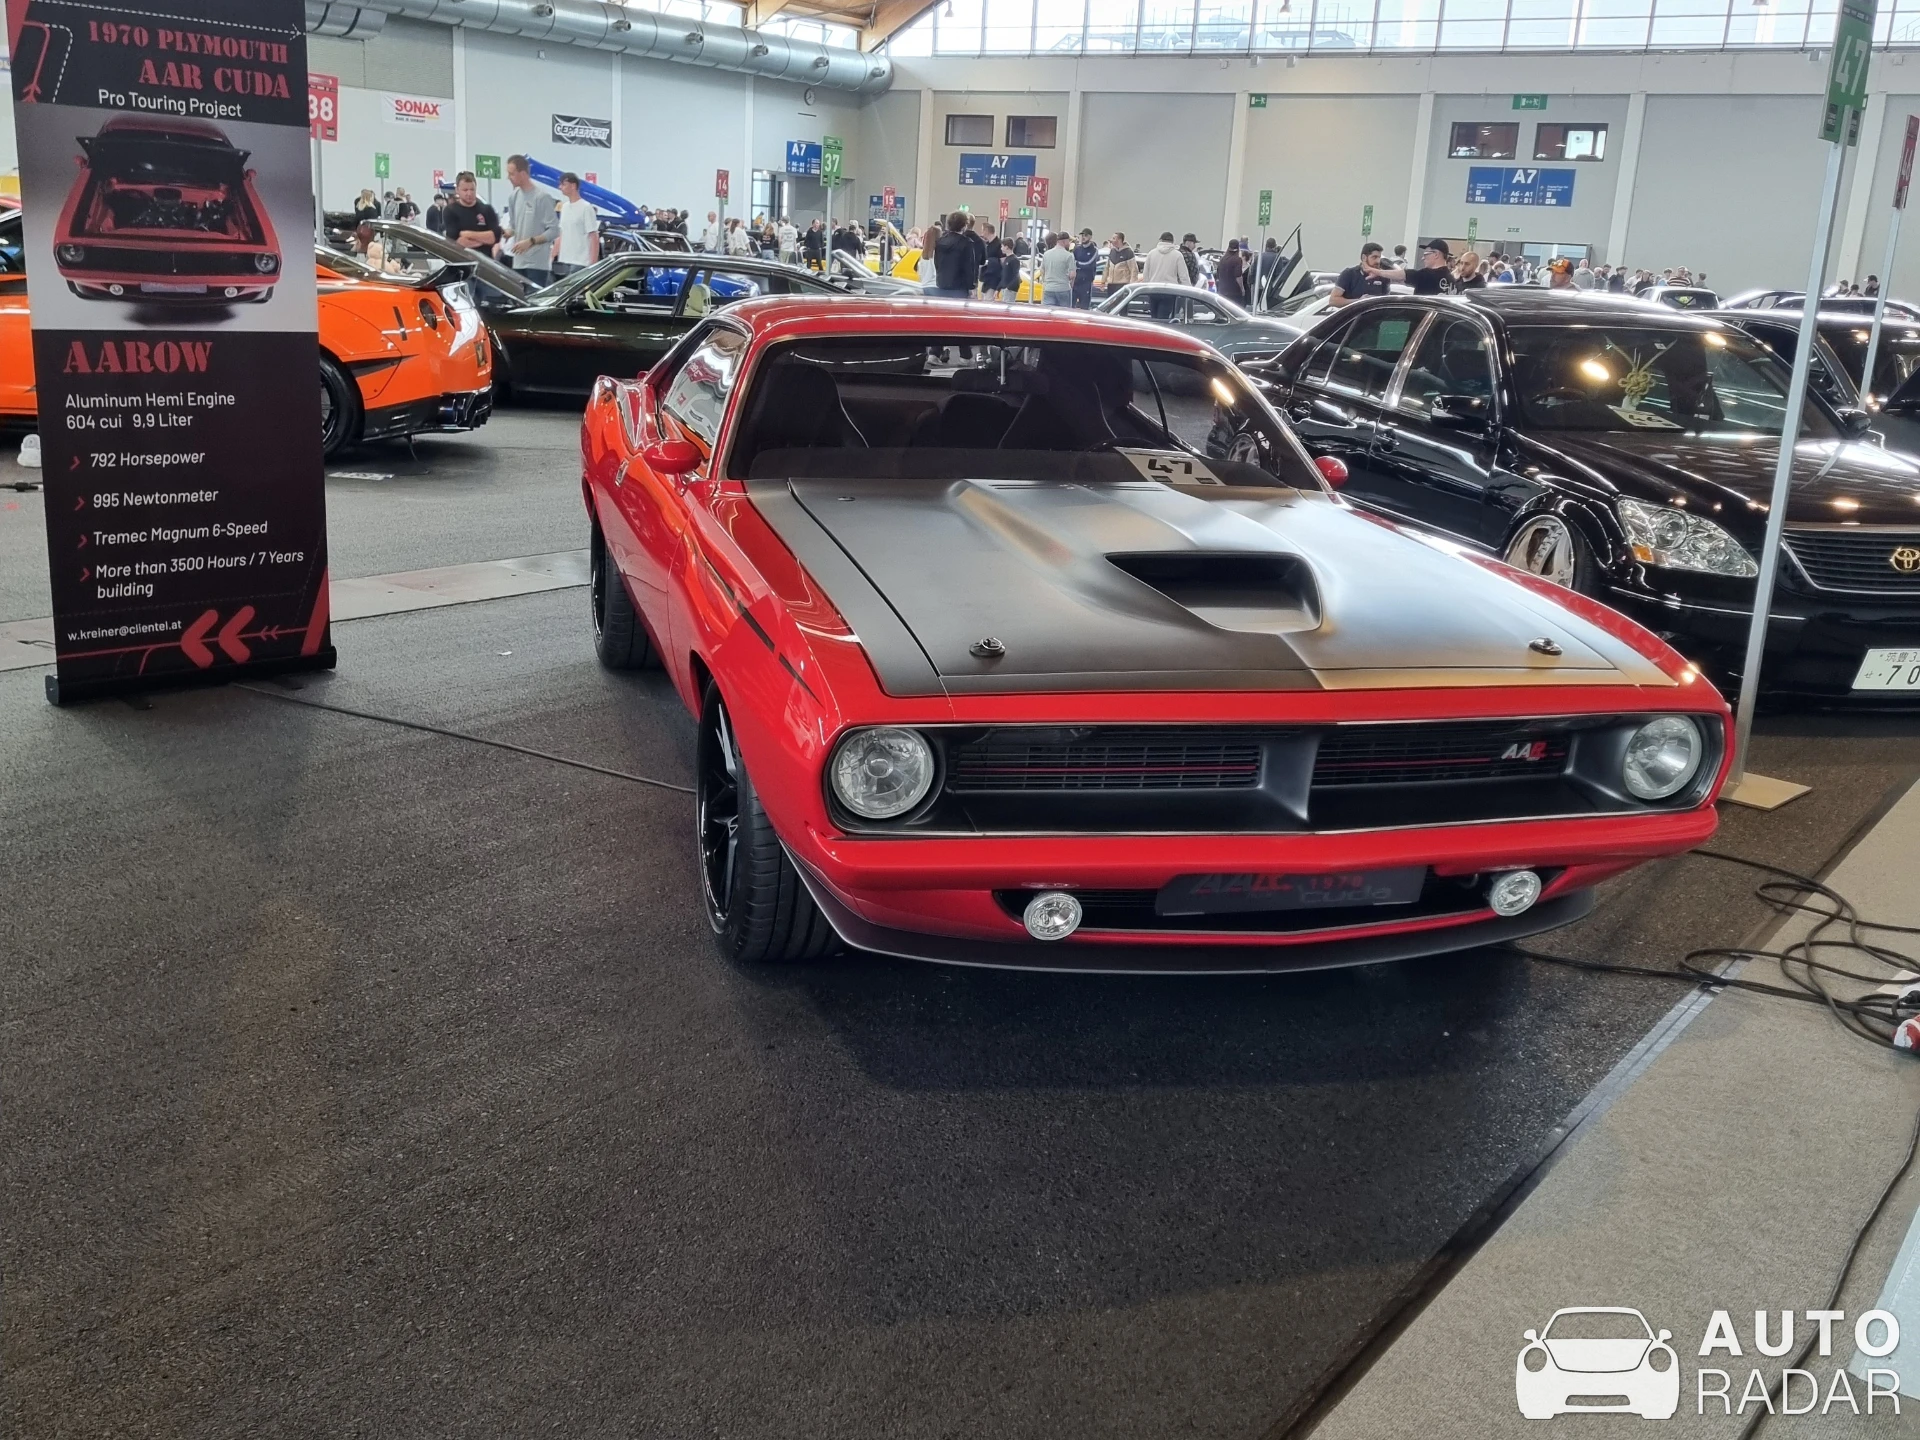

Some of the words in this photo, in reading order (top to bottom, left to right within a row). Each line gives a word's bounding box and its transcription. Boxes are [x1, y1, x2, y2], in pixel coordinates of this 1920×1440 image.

[89, 21, 149, 47] 1970
[157, 29, 289, 64] PLYMOUTH
[1835, 35, 1868, 96] 47
[139, 59, 204, 90] AAR
[213, 67, 291, 98] CUDA
[98, 88, 125, 106] Pro
[129, 92, 186, 116] Touring
[189, 98, 242, 118] Project
[309, 94, 334, 121] 38
[395, 100, 440, 116] SONAX
[791, 143, 807, 156] A7
[824, 153, 840, 172] 37
[991, 155, 1009, 169] A7
[718, 179, 727, 191] 14
[1512, 169, 1538, 184] A7
[885, 195, 894, 206] 15
[1261, 202, 1270, 215] 35
[1001, 207, 1007, 216] 16
[63, 341, 213, 373] AAROW
[65, 393, 142, 409] Aluminum
[145, 392, 184, 407] Hemi
[187, 392, 236, 409] Engine
[66, 414, 96, 430] 604
[99, 414, 122, 429] cui
[132, 413, 155, 428] 9,9
[159, 412, 194, 427] Liter
[90, 453, 117, 468] 792
[120, 452, 206, 468] Horsepower
[1147, 459, 1193, 475] 47
[93, 493, 120, 508] 995
[123, 490, 219, 507] Newtonmeter
[93, 531, 148, 546] Tremec
[150, 525, 210, 543] Magnum
[212, 520, 268, 537] 6-Speed
[95, 564, 132, 579] More
[134, 560, 167, 575] than
[170, 556, 205, 573] 3500
[207, 553, 247, 569] Hours
[249, 552, 255, 566] /
[258, 552, 266, 565] 7
[268, 550, 304, 564] Years
[97, 582, 154, 599] building
[67, 620, 182, 641] w.kreiner@clientel.at
